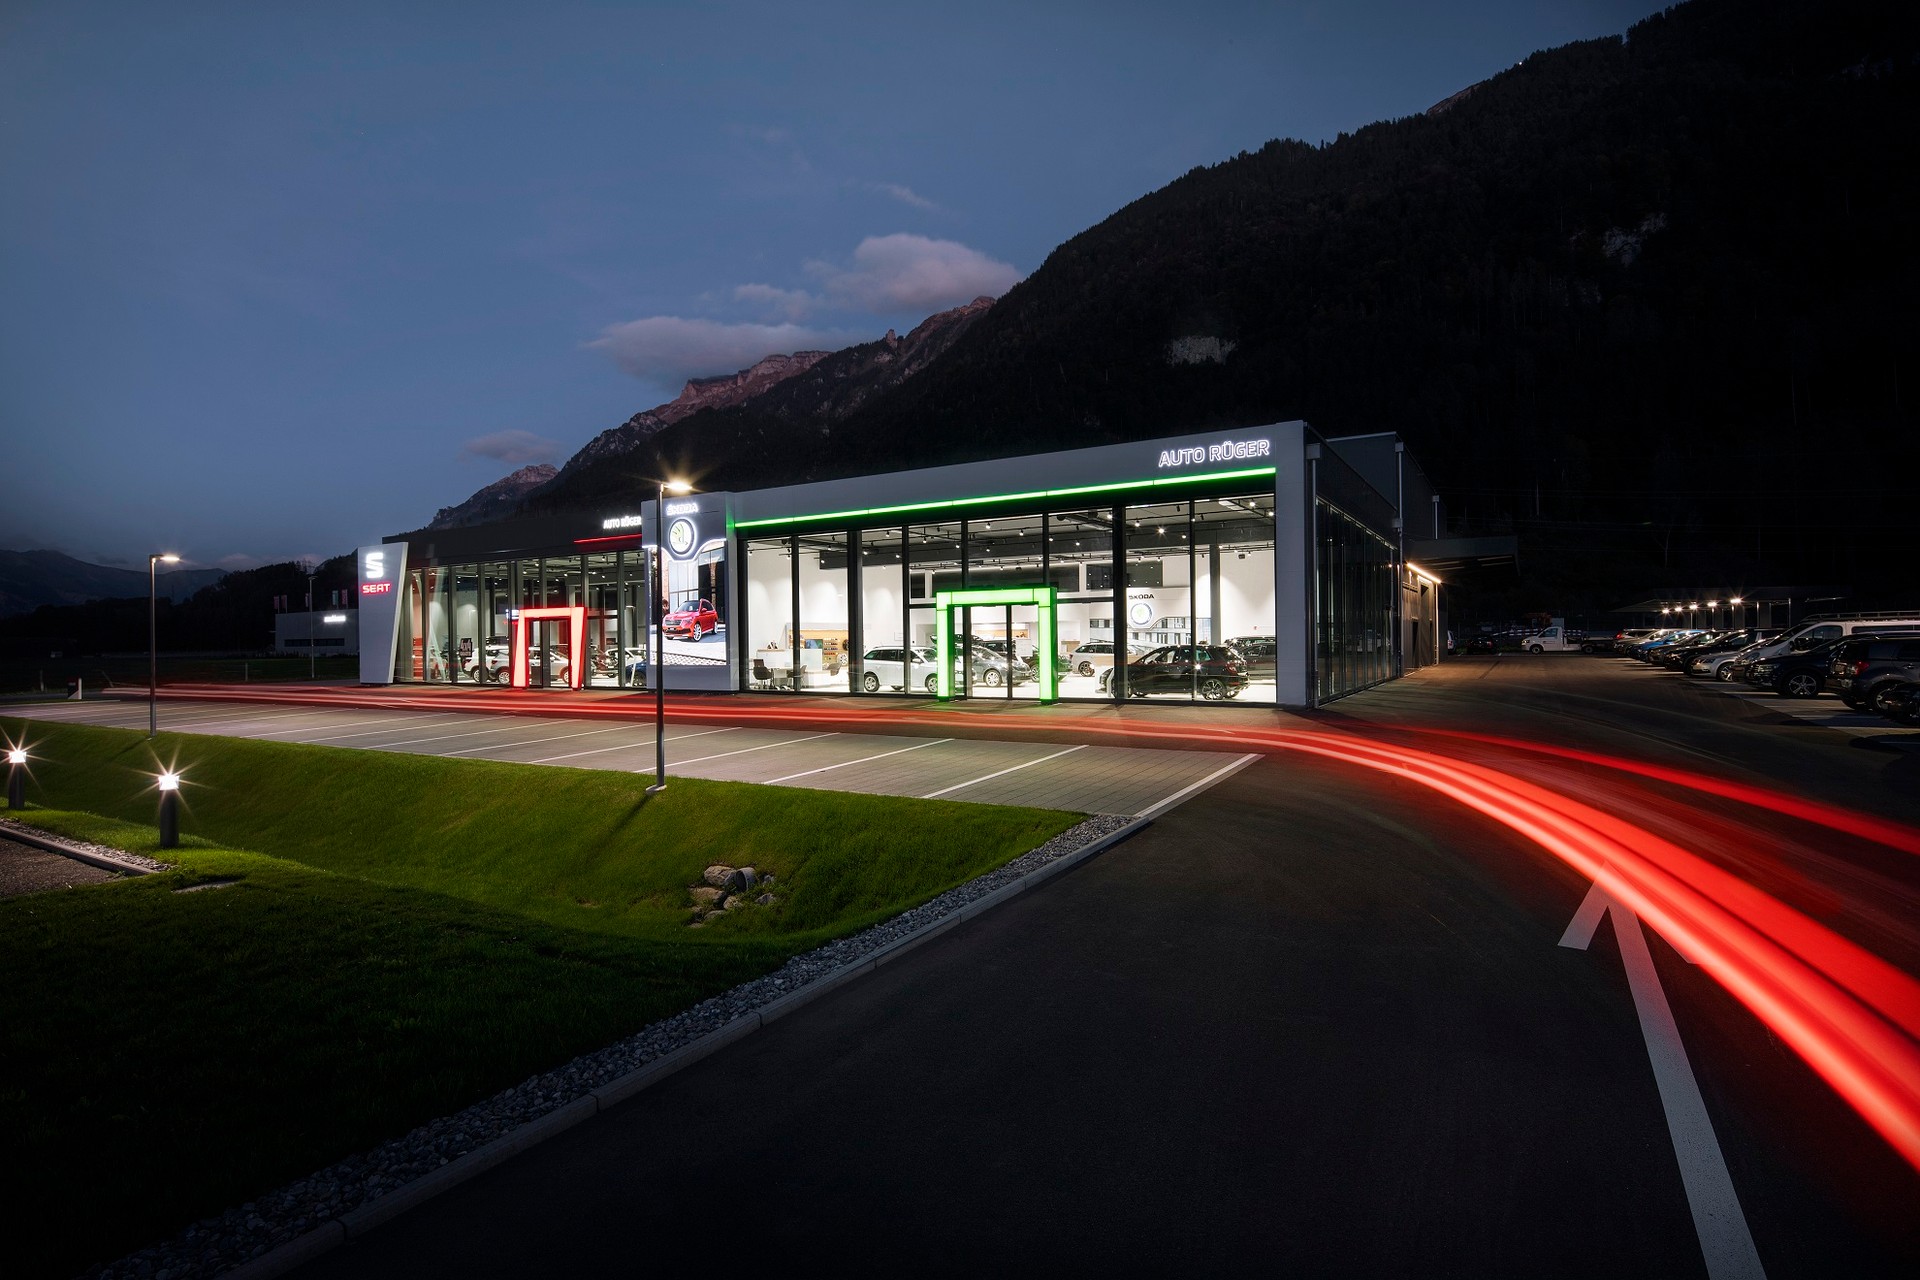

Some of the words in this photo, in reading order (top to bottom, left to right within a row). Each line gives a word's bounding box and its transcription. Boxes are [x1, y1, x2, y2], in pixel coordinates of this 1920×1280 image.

[1158, 447, 1205, 467] AUTO
[1209, 440, 1270, 462] RÜGER
[603, 518, 620, 529] AUTO
[362, 583, 391, 594] SEAT
